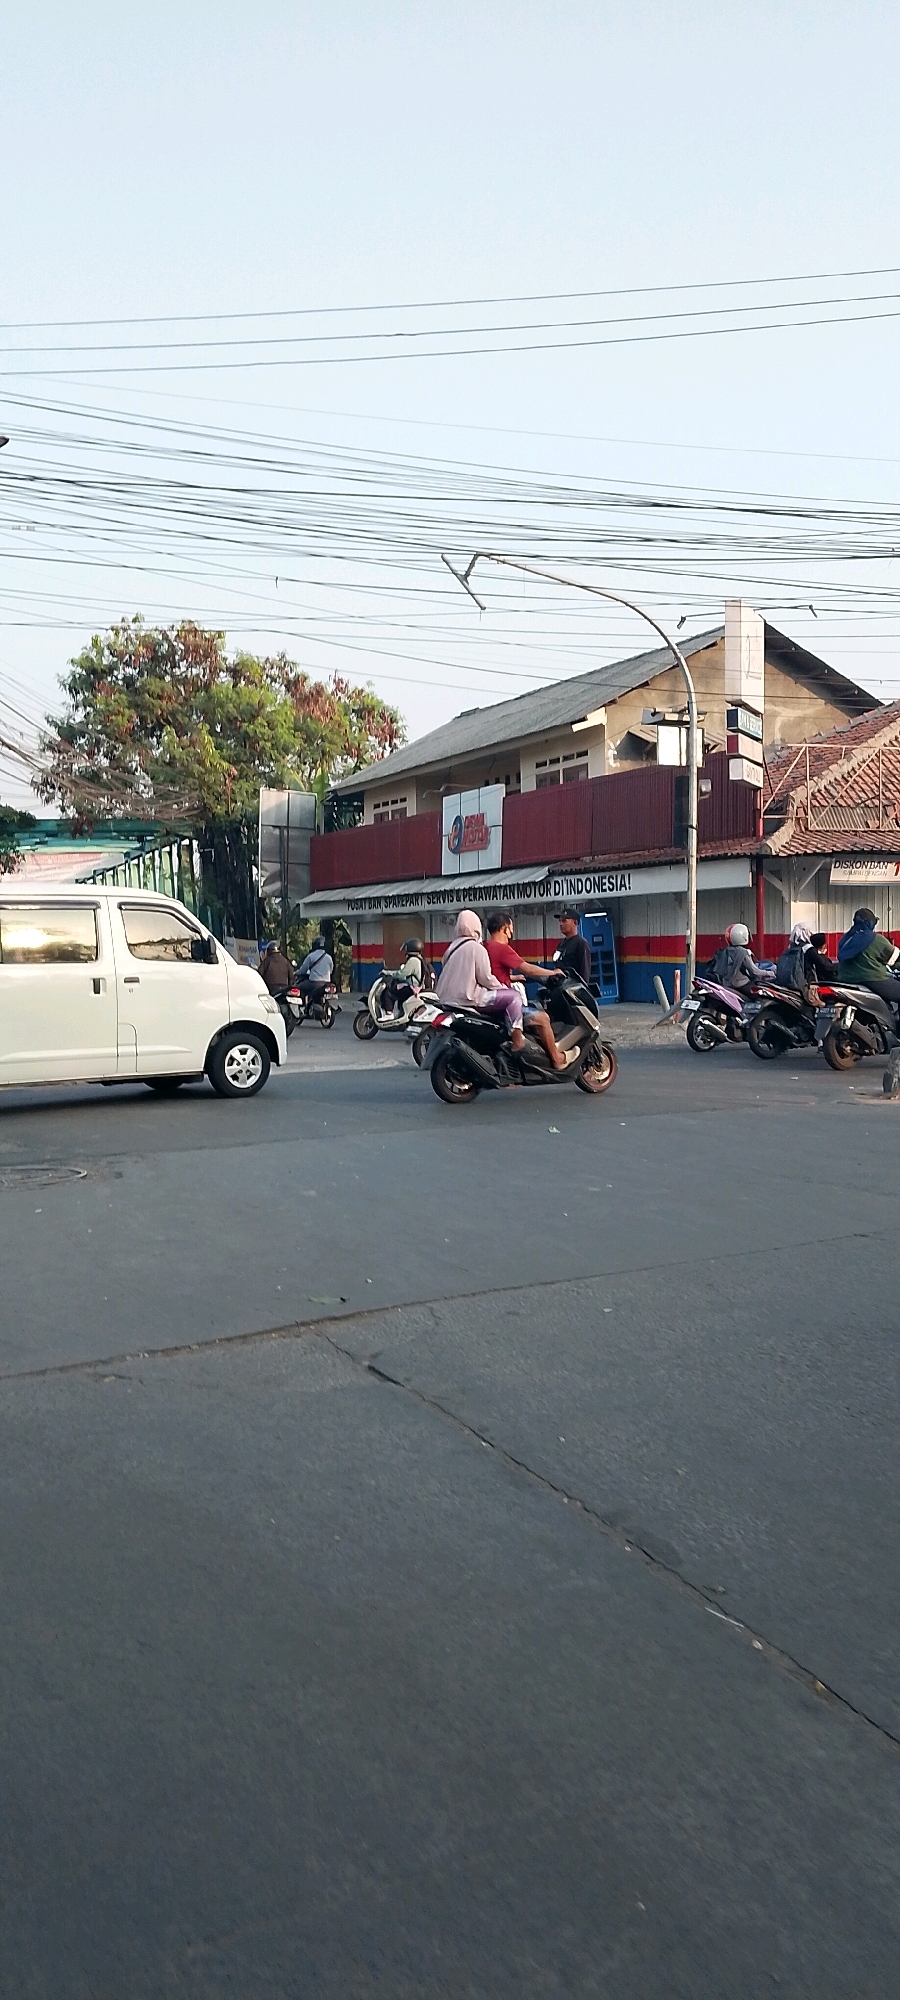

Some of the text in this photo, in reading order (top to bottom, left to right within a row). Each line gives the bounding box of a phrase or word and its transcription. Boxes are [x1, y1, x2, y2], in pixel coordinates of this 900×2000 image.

[834, 860, 868, 870] DISKON
[426, 889, 454, 905] SERVIS
[462, 885, 515, 902] PERAWATAN
[516, 881, 552, 899] MOTOR
[554, 879, 564, 897] DI
[564, 873, 632, 896] INDONESIA!
